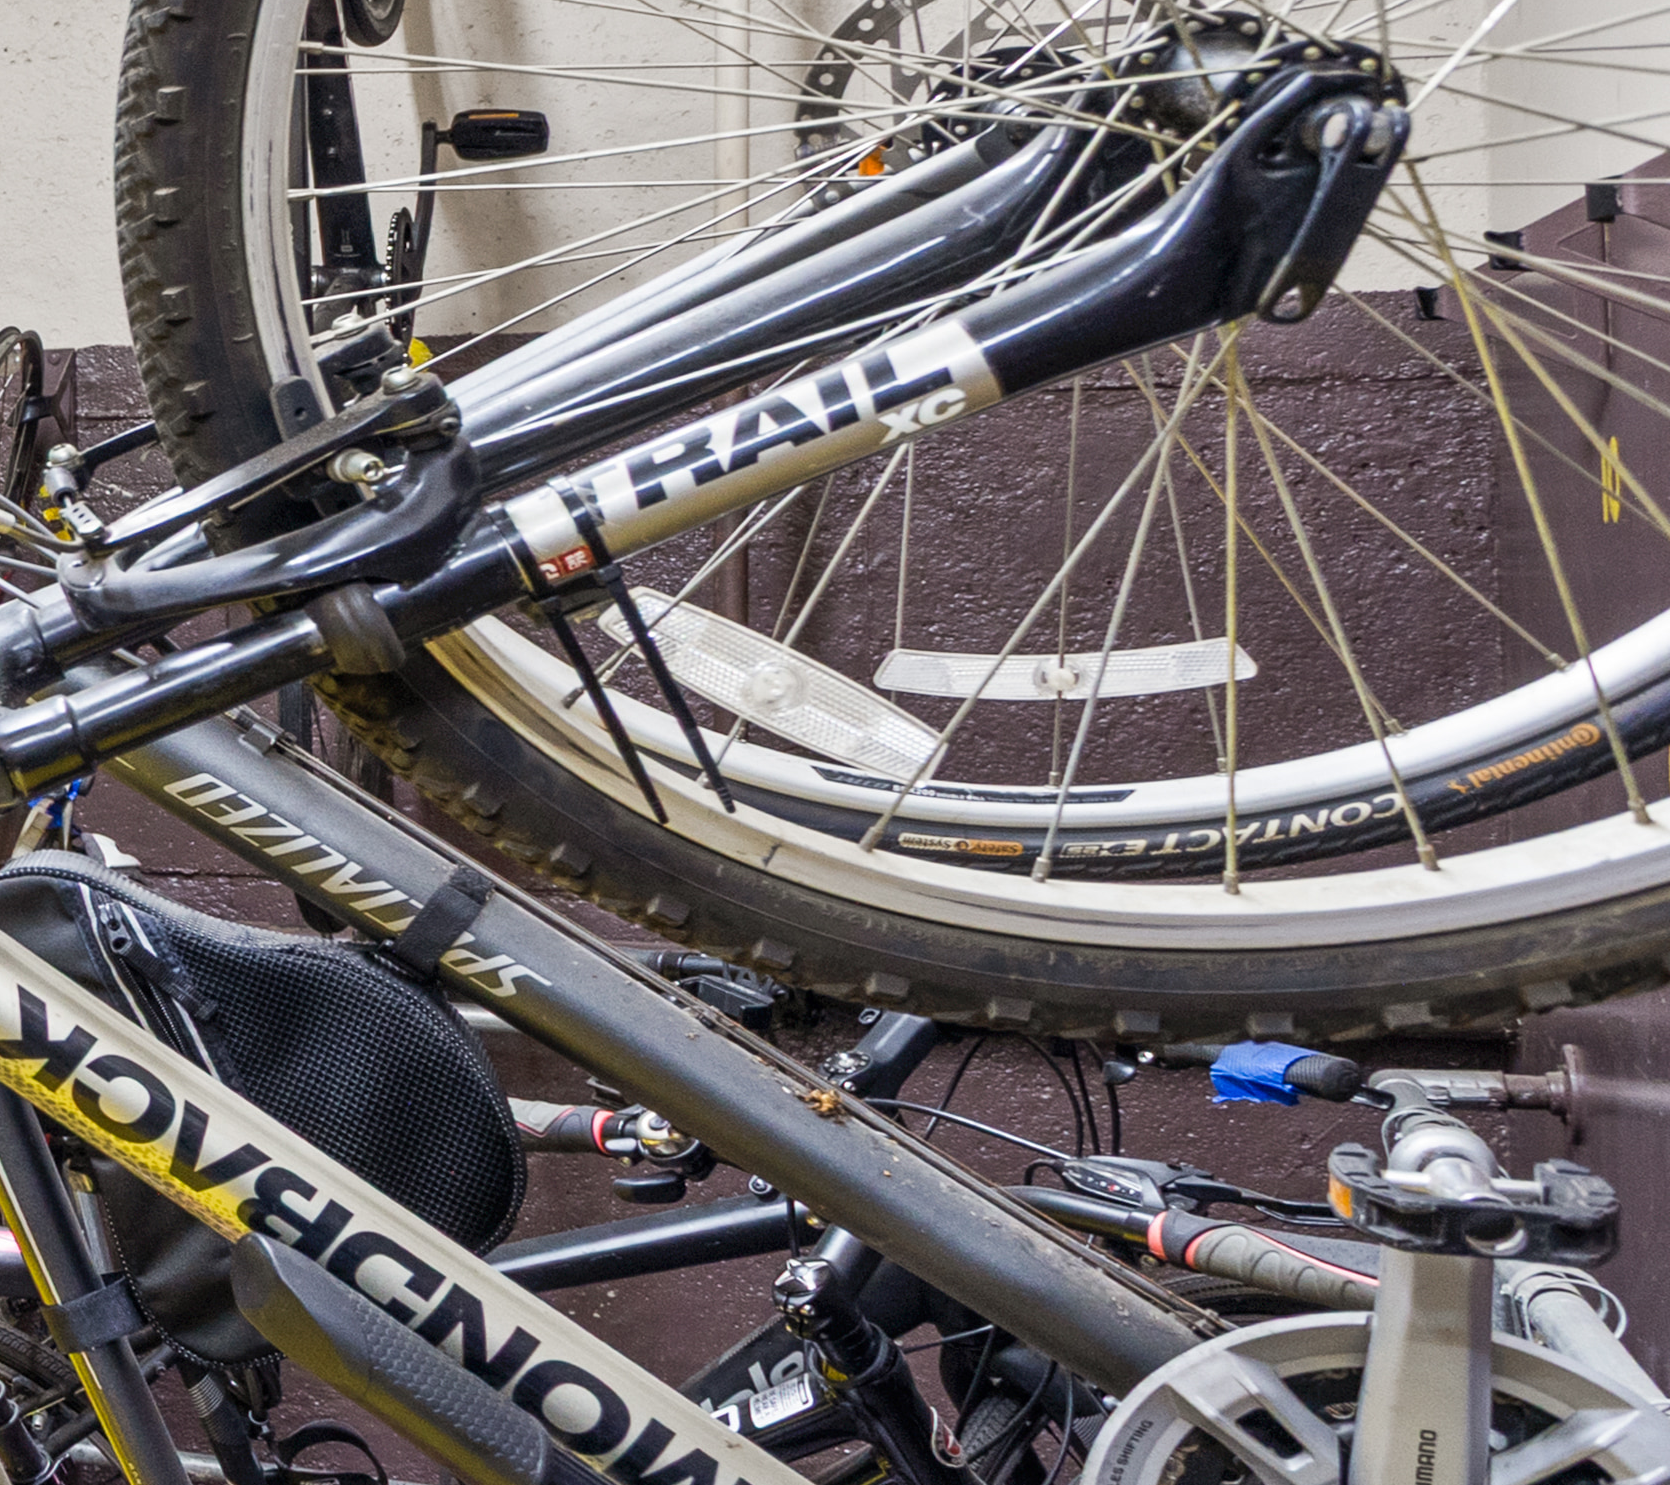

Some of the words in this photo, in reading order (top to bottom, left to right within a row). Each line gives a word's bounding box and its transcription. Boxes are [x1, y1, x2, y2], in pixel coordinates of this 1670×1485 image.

[878, 390, 966, 445] XC
[1152, 793, 1403, 857] CONTACT
[1120, 1418, 1152, 1468] SHIFTING
